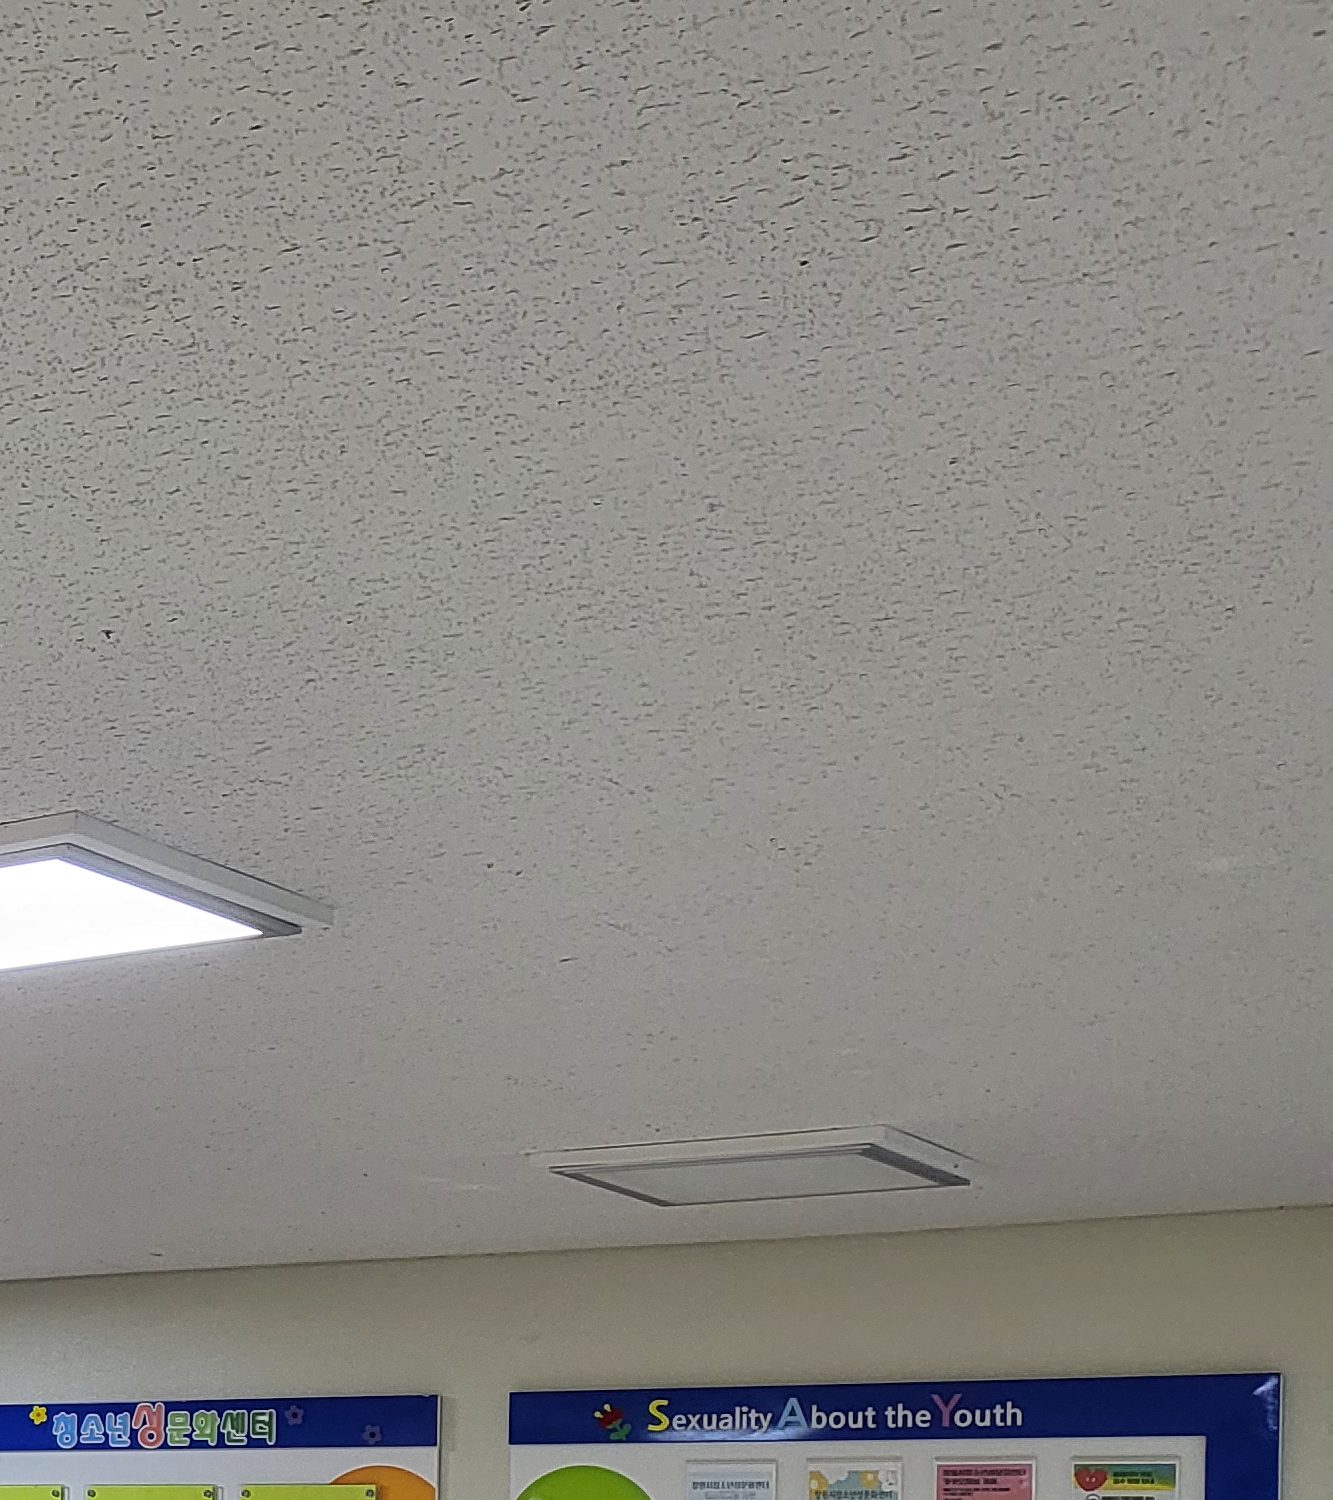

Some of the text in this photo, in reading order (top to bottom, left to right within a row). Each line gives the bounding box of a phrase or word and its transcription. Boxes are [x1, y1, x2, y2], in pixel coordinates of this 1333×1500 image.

[52, 1402, 277, 1448] 청소년성문화센터
[647, 1394, 1023, 1434] Sexuality About the Youth
